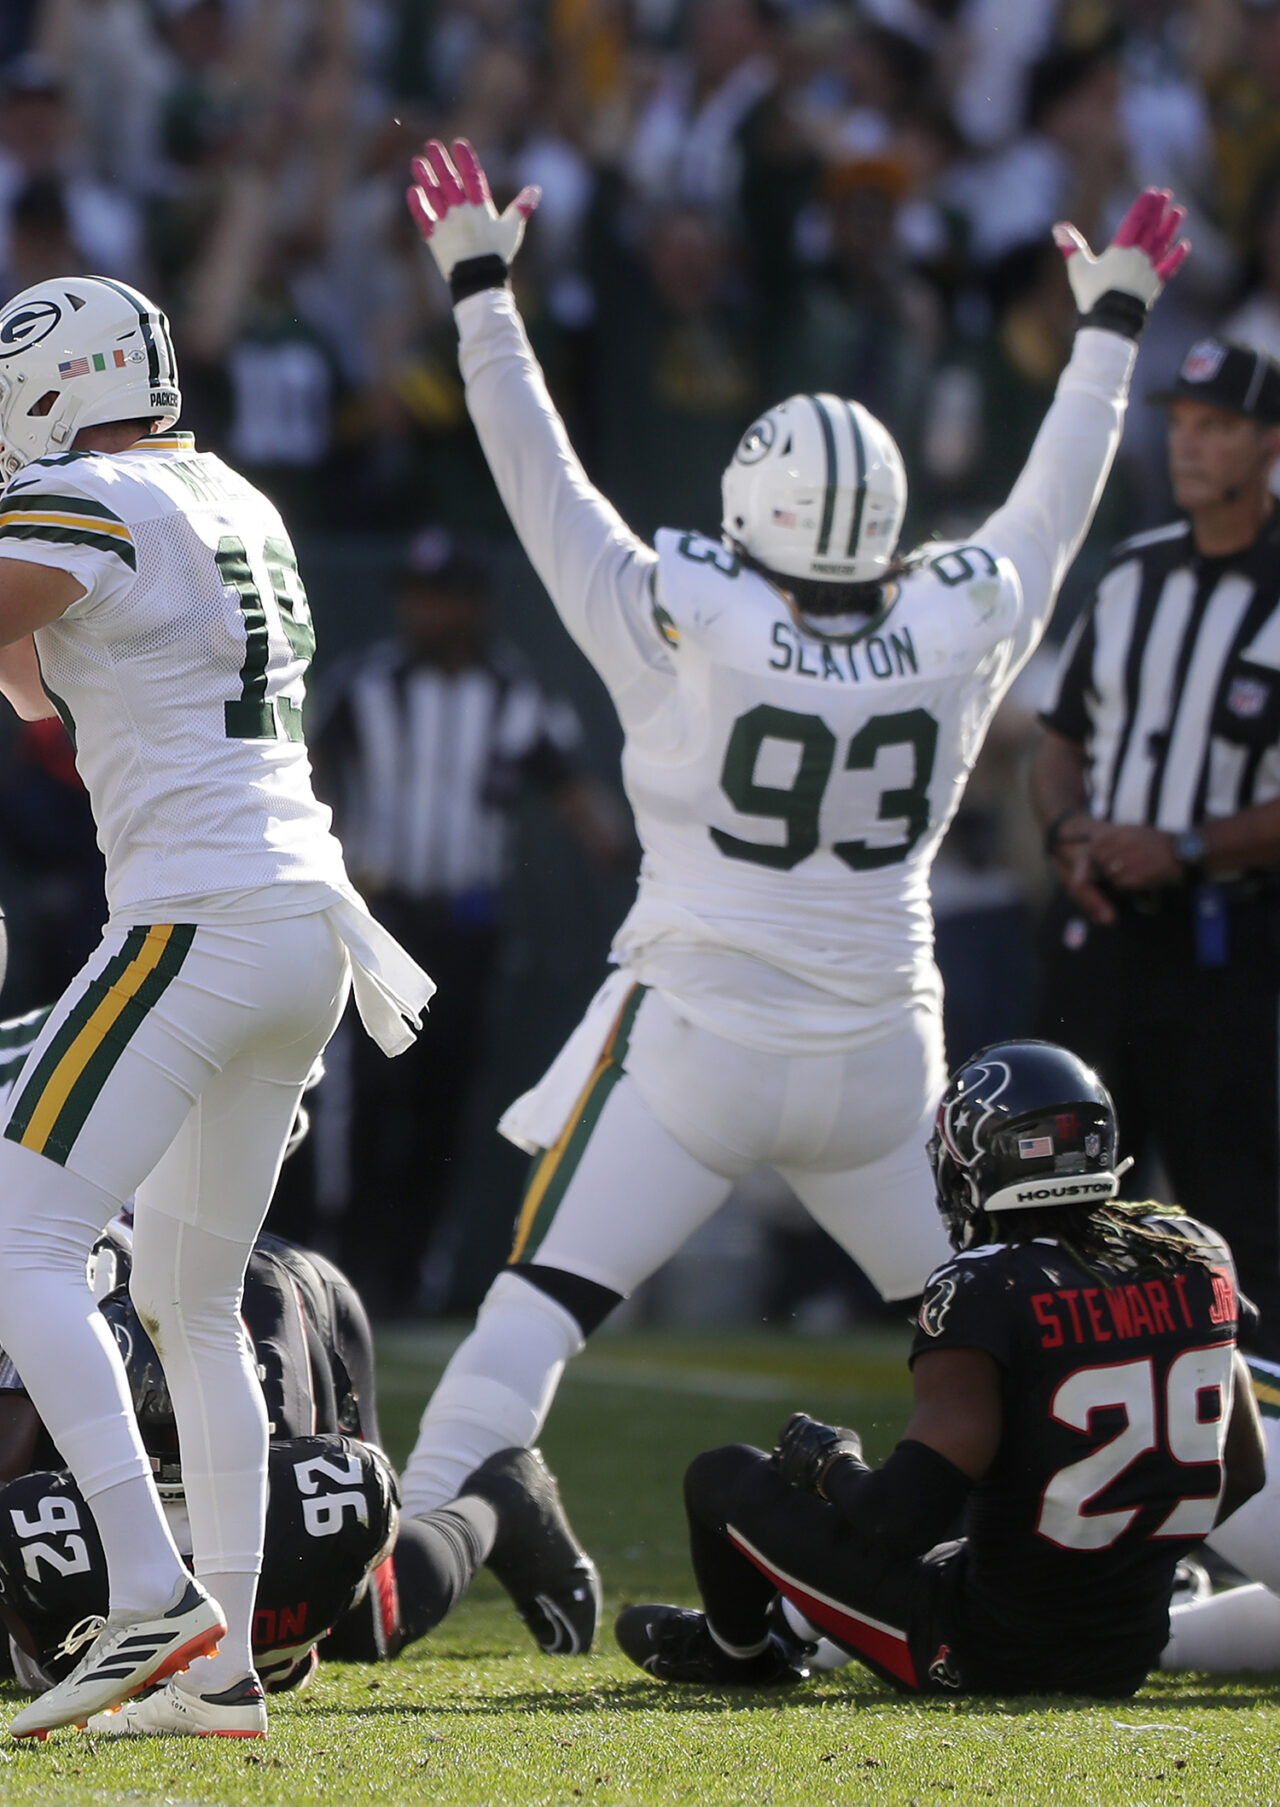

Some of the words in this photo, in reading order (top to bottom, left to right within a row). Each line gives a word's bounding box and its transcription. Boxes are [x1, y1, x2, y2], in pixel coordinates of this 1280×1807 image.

[214, 535, 317, 743] 19
[768, 620, 918, 683] SLATON
[708, 703, 939, 873] 93
[1017, 1182, 1113, 1203] HOUSTON
[1030, 1273, 1194, 1349] STEWART
[1033, 1337, 1237, 1553] 29
